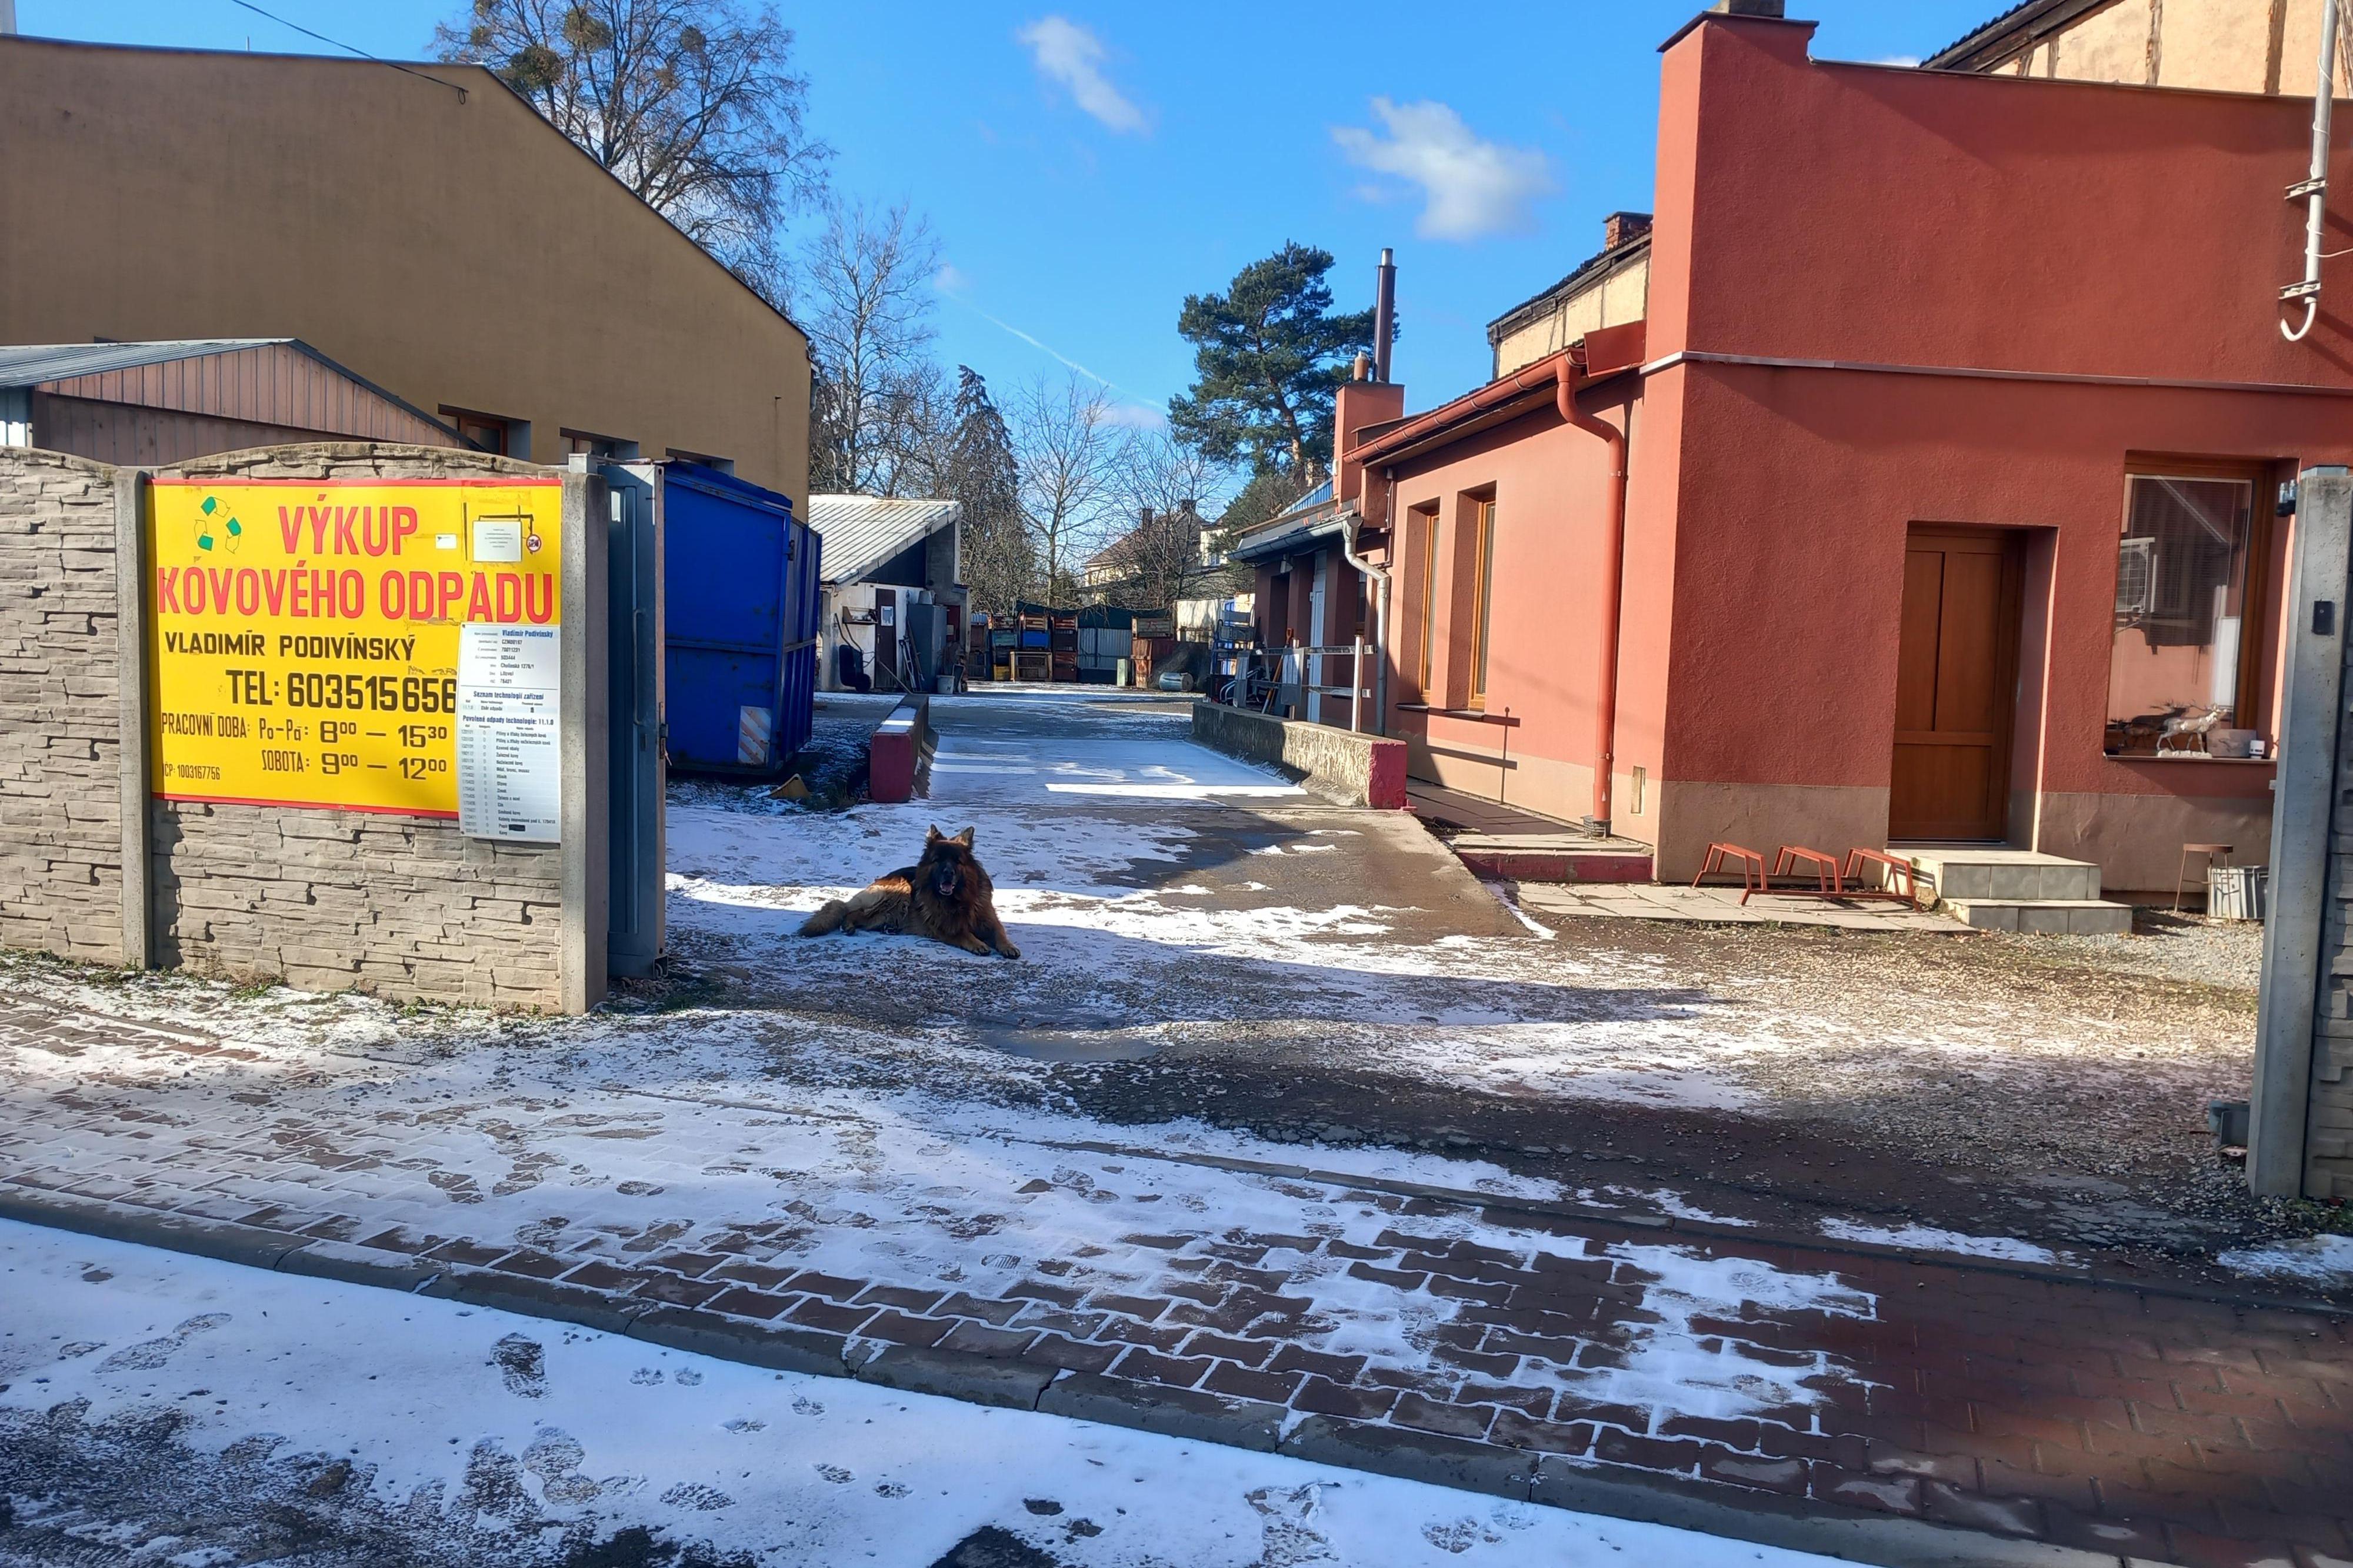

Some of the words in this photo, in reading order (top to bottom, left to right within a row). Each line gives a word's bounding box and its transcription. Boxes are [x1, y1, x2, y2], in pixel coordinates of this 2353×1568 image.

[278, 494, 417, 556] VÝKUP
[158, 560, 364, 619] KOVOVÉHO
[380, 571, 552, 623] ODPADU
[165, 630, 265, 656] VLADIMÍR
[279, 632, 415, 661] PODIVÍNSKÝ
[162, 712, 215, 736] PRACOVNÍ
[218, 716, 250, 738] DOBA:
[177, 764, 221, 780] 1003167756
[262, 750, 309, 772] SOBOTA:
